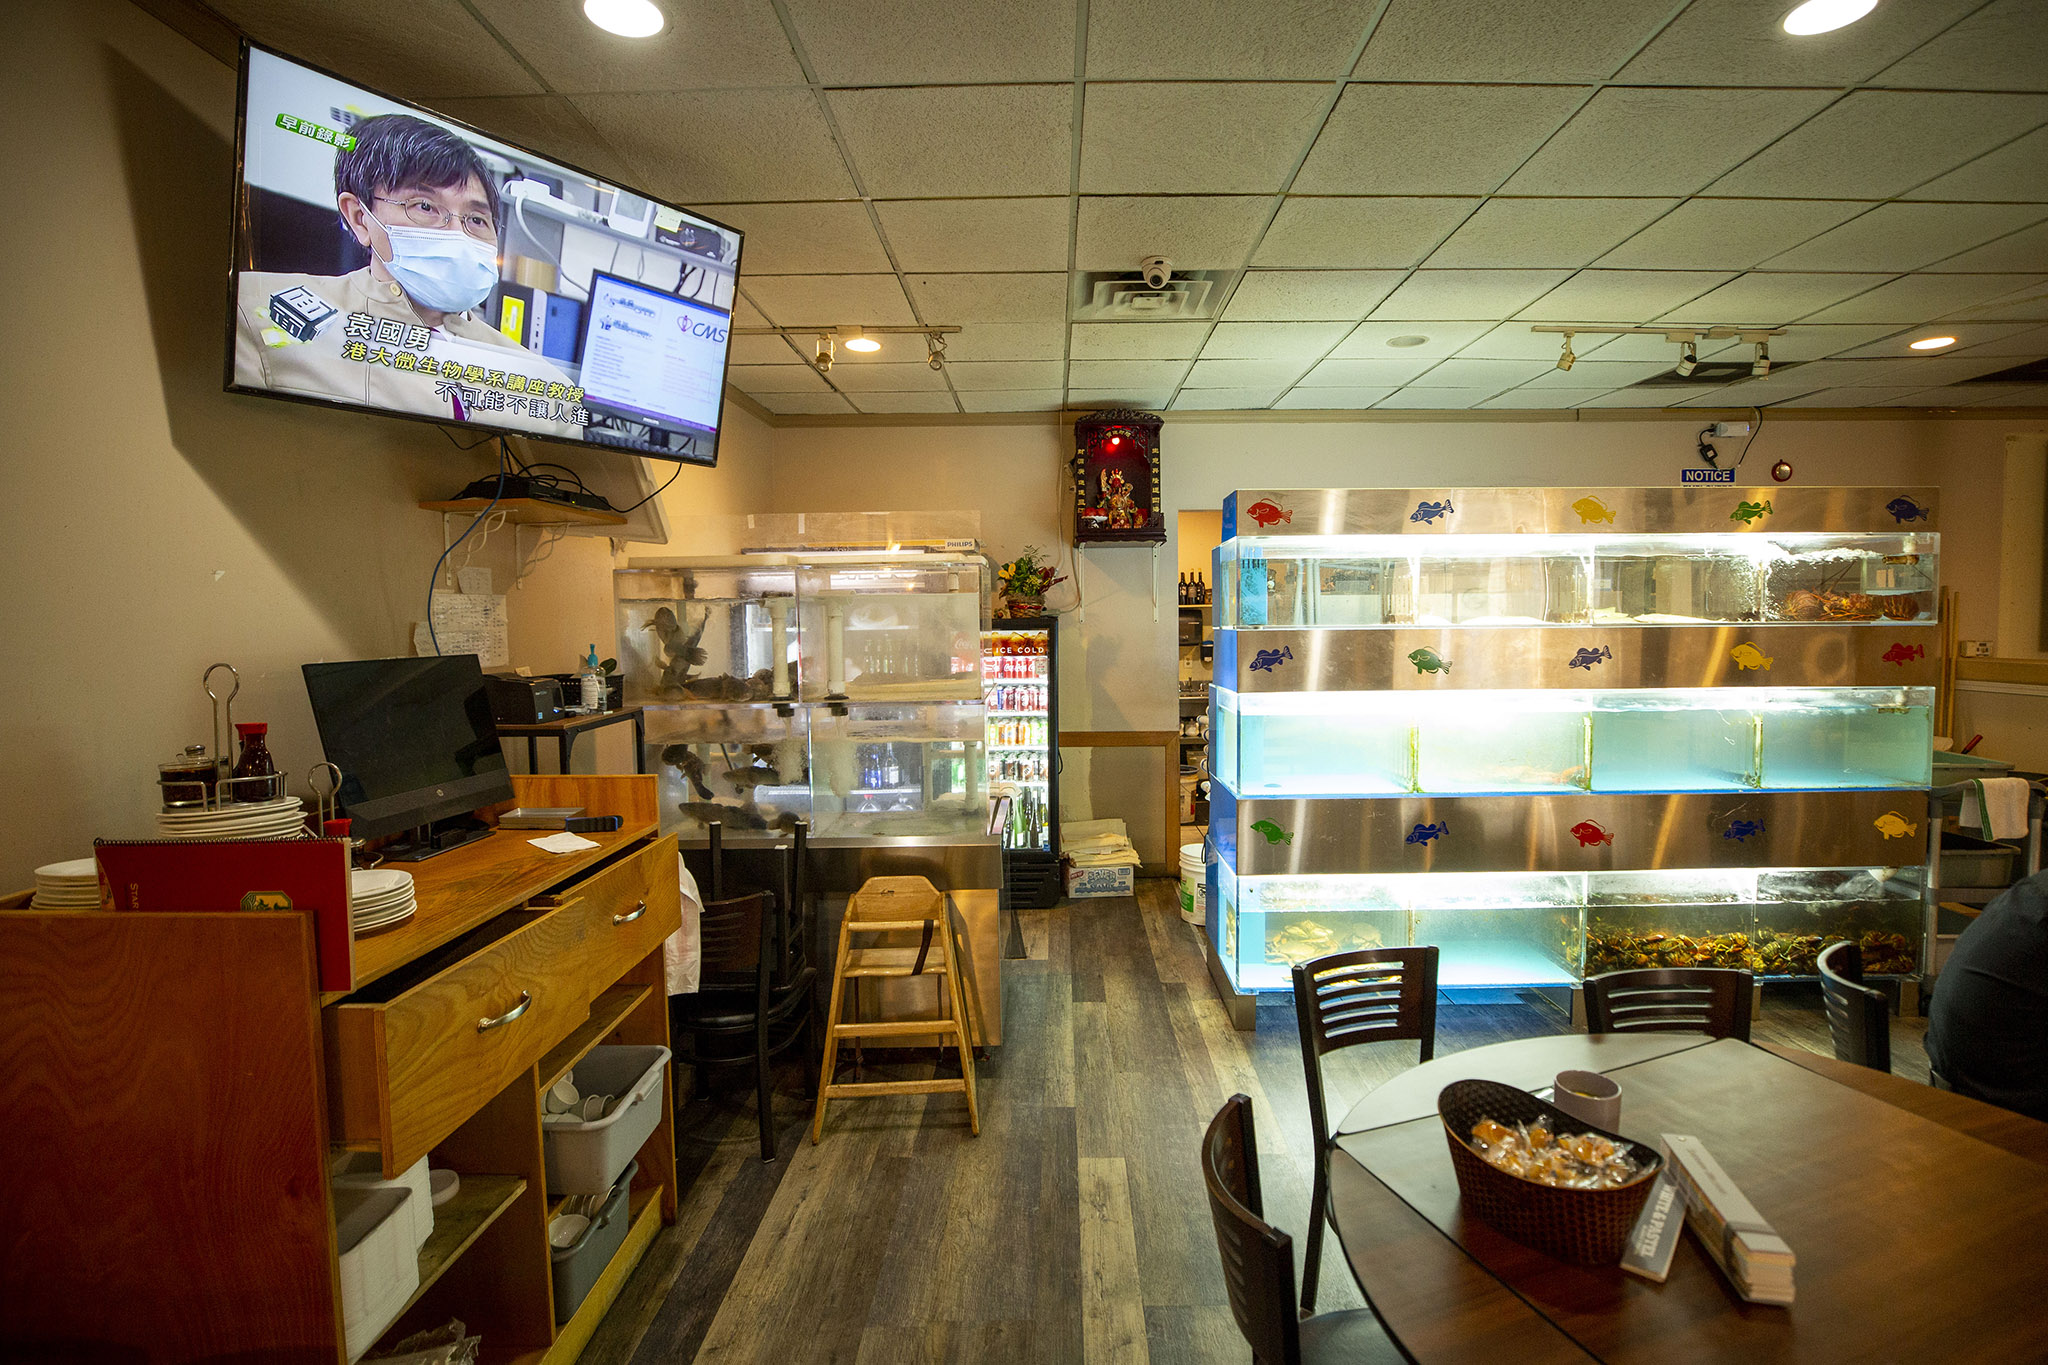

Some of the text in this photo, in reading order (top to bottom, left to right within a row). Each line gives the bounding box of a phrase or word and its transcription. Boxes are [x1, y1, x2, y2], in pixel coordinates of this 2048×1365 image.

[279, 114, 351, 148] 早前錄影
[345, 312, 432, 351] 袁國勇
[692, 322, 728, 343] CMS
[341, 340, 585, 404] 港大微生物學系講座教授
[435, 380, 590, 427] 不可能不讓人進
[1686, 470, 1730, 481] NOTICE
[996, 646, 1045, 654] ICE COLD
[1639, 1219, 1665, 1258] PASTEL
